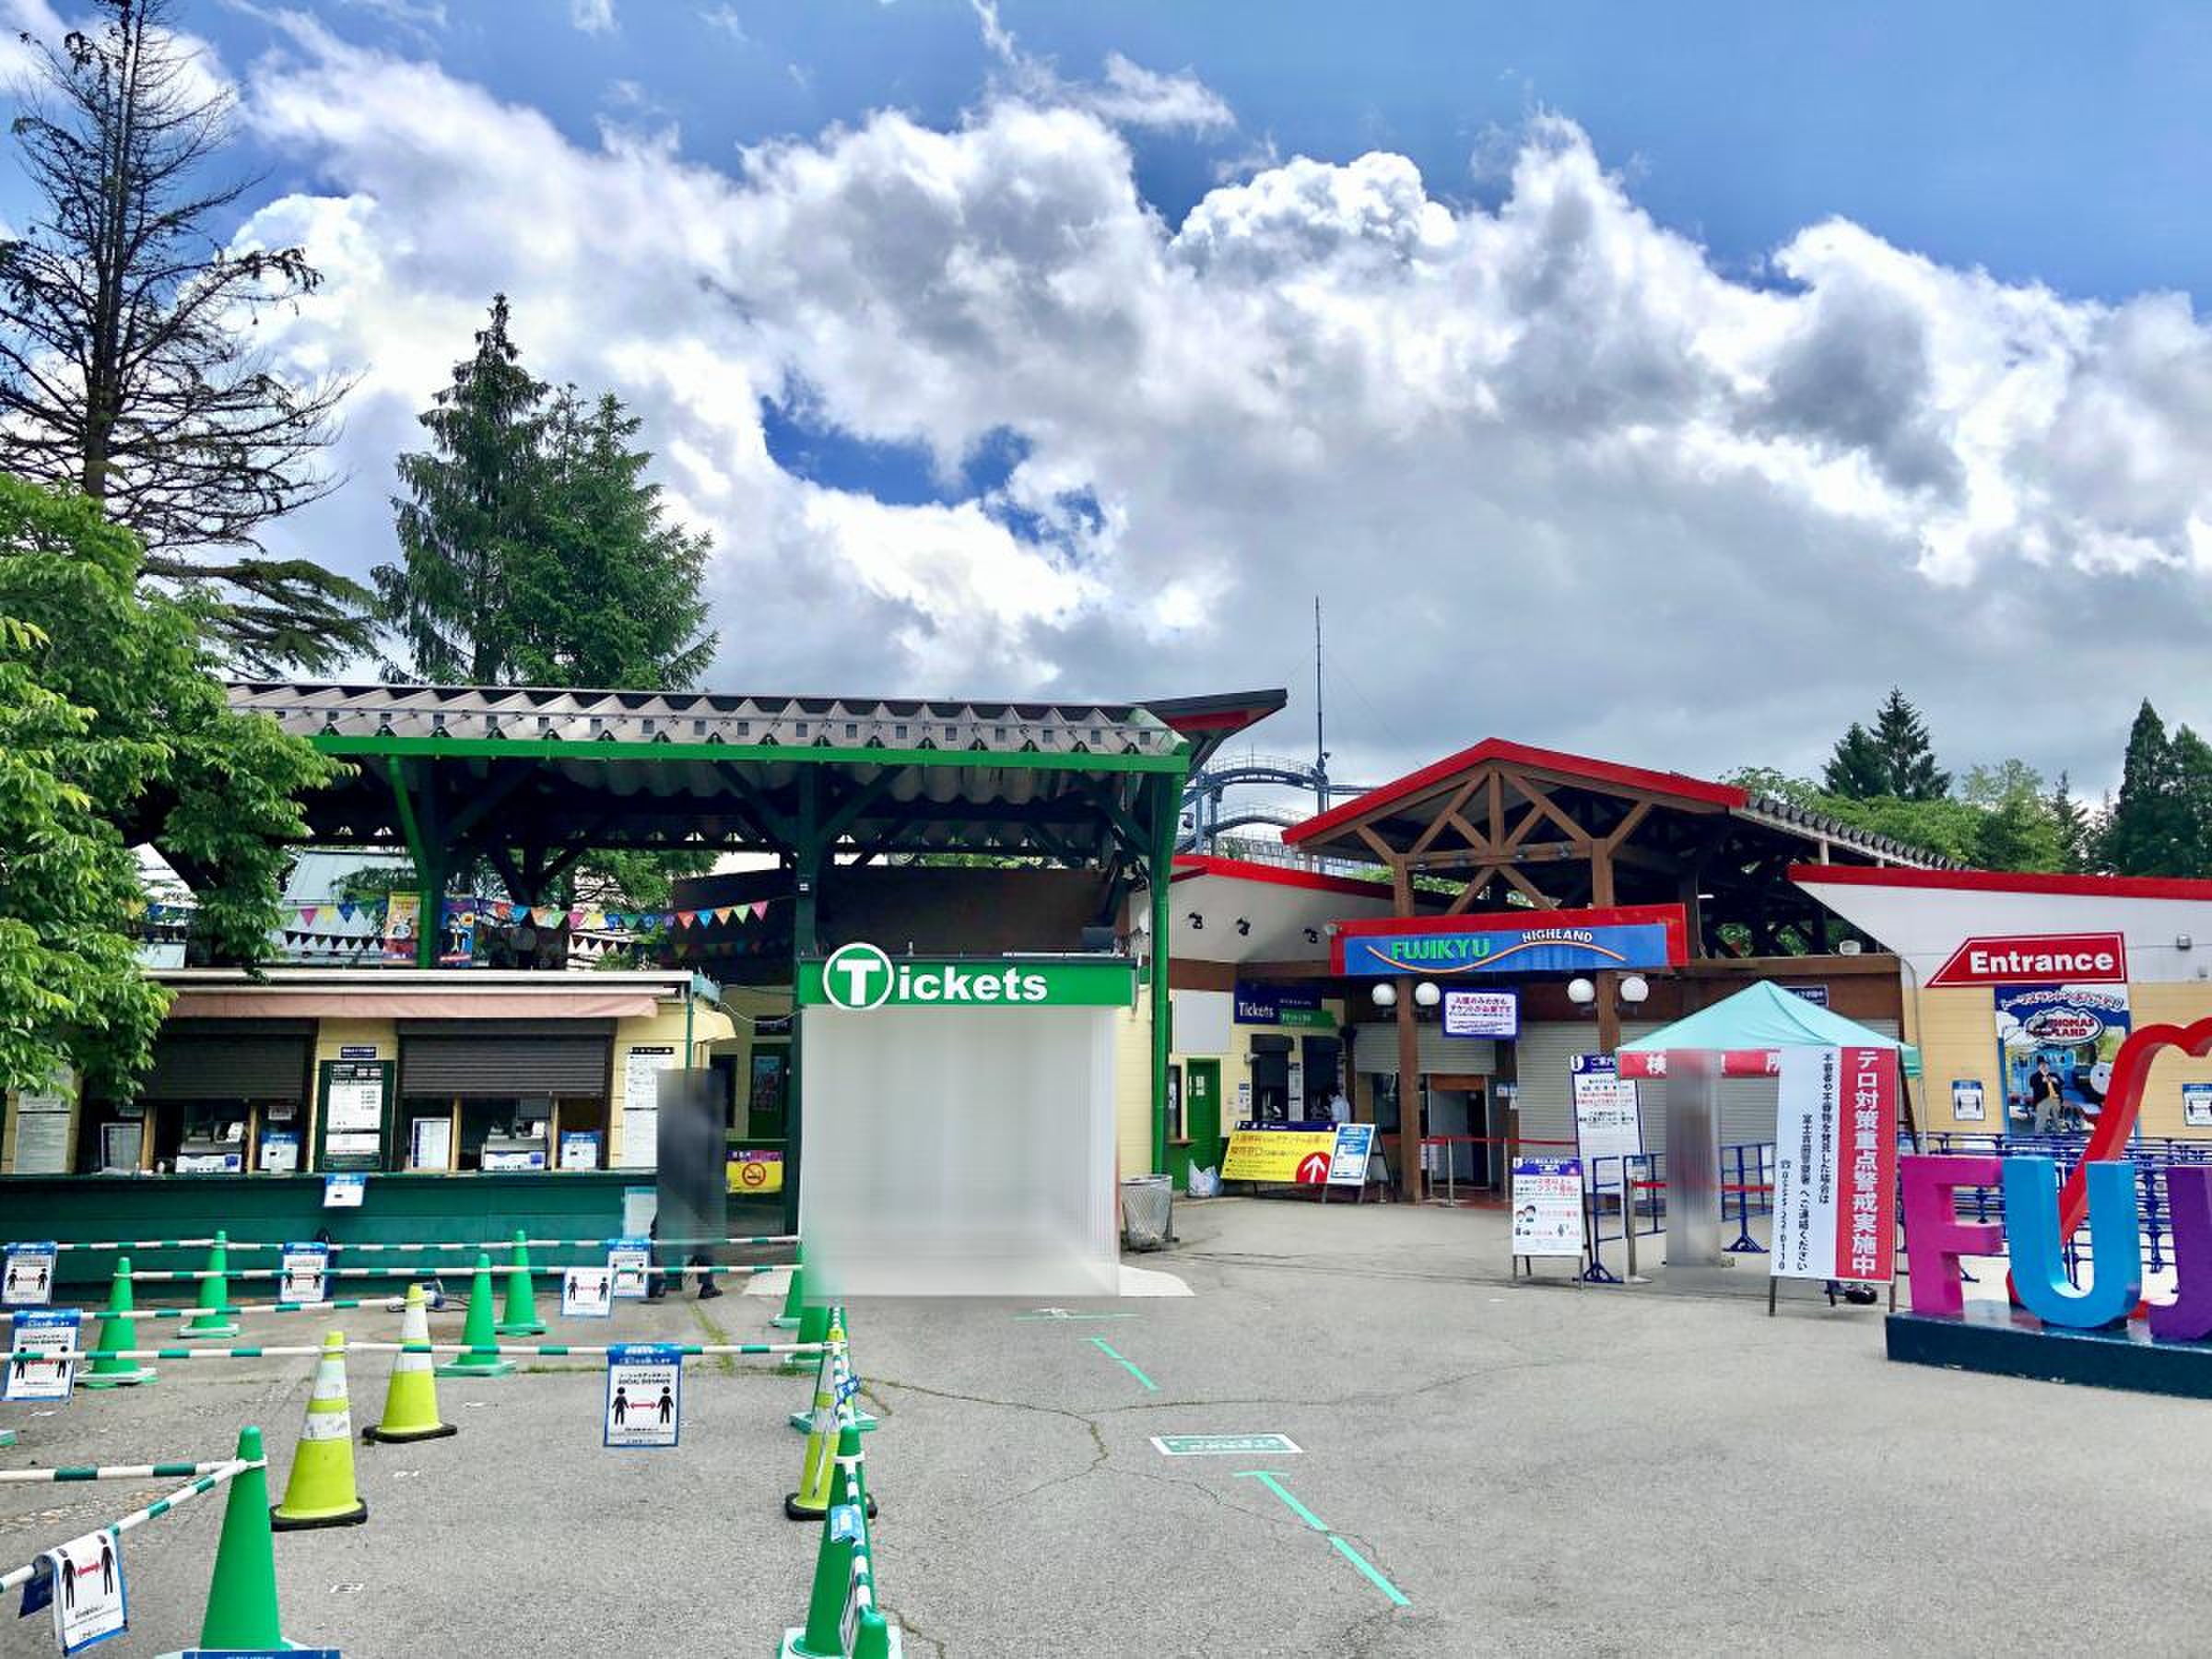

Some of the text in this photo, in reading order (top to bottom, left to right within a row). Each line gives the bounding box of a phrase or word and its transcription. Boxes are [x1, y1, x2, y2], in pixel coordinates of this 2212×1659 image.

[1522, 928, 1594, 944] HIGHLAND
[1392, 937, 1491, 959] FUJIKYU
[1970, 950, 2114, 973] Entrance
[836, 959, 1049, 1006] Tickets
[1238, 1002, 1274, 1018] Tickets
[2046, 1018, 2095, 1027] THOMAS
[2053, 1028, 2088, 1037] LAND
[1852, 1051, 1879, 1277] テロ対策重点警戒実施中
